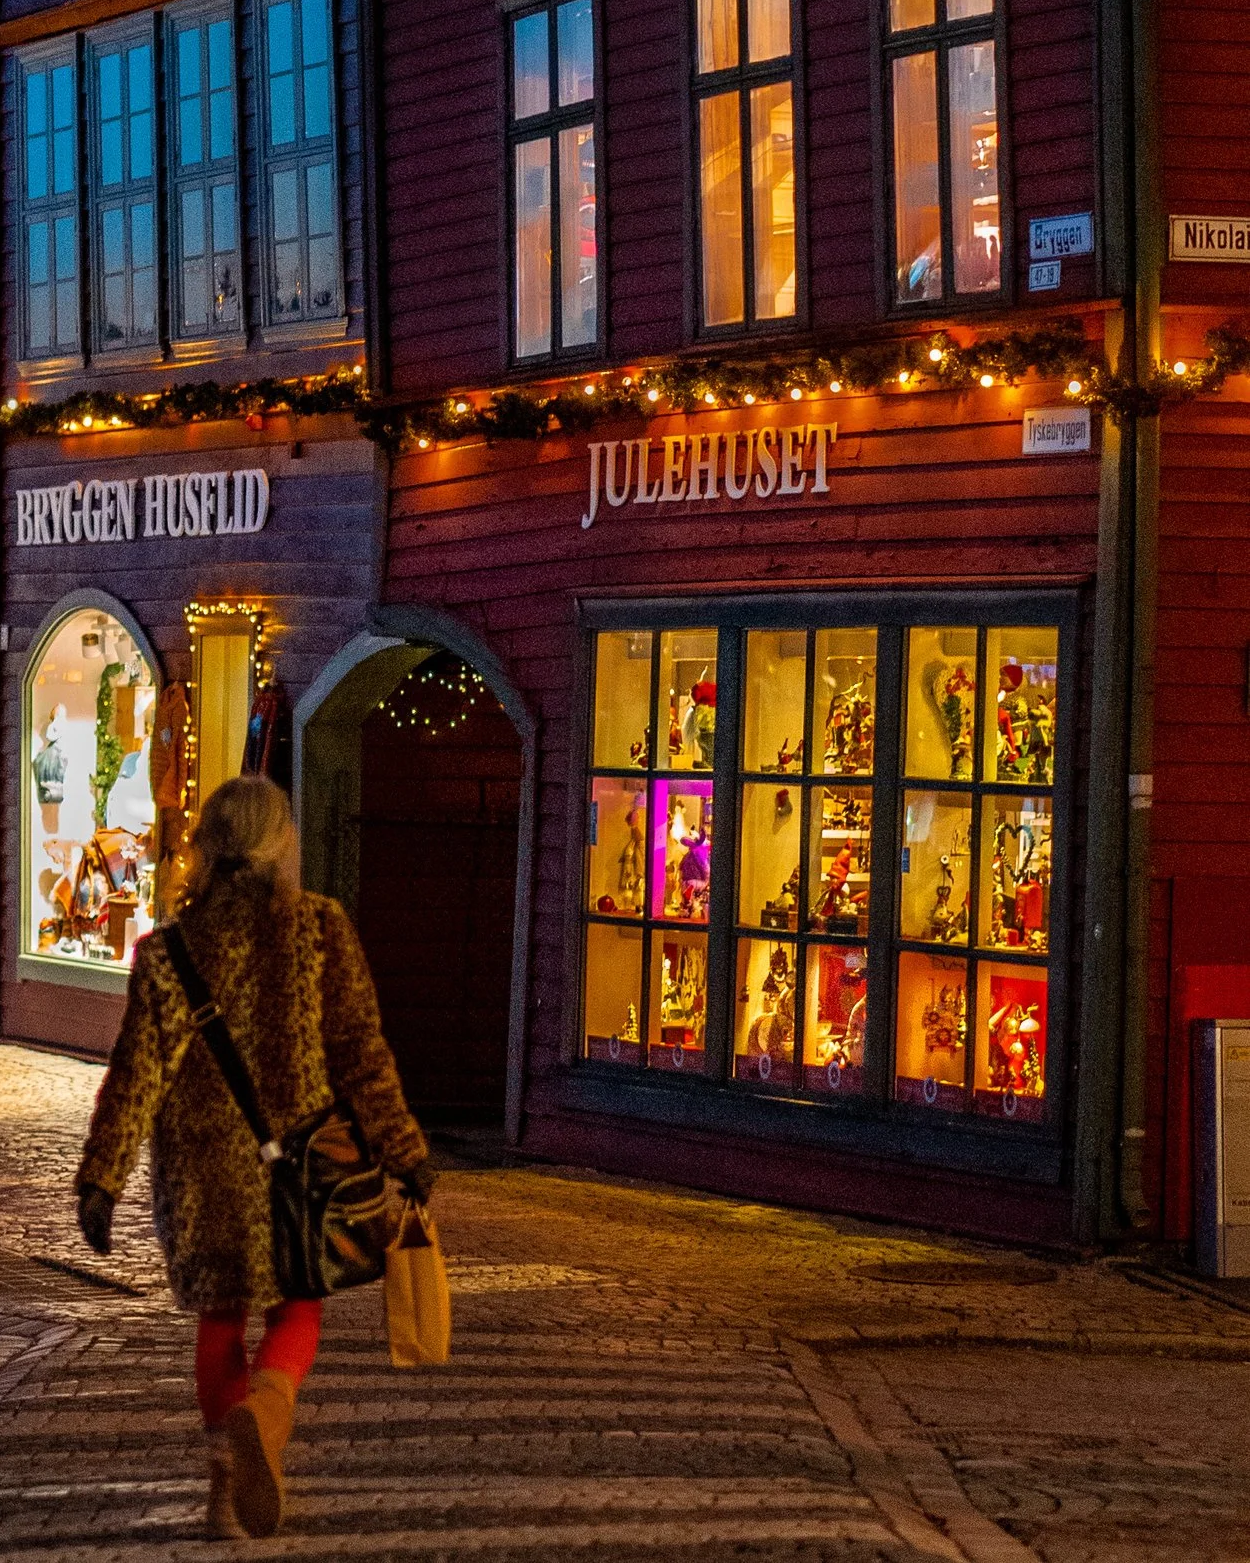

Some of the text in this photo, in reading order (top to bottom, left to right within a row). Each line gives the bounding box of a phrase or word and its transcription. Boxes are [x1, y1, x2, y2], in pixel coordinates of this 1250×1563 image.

[1035, 225, 1082, 255] Bryggen
[1028, 417, 1086, 447] Tyskebryggen
[581, 422, 838, 529] JULEHUSET
[16, 469, 269, 546] BRYGGEN HUSFLID
